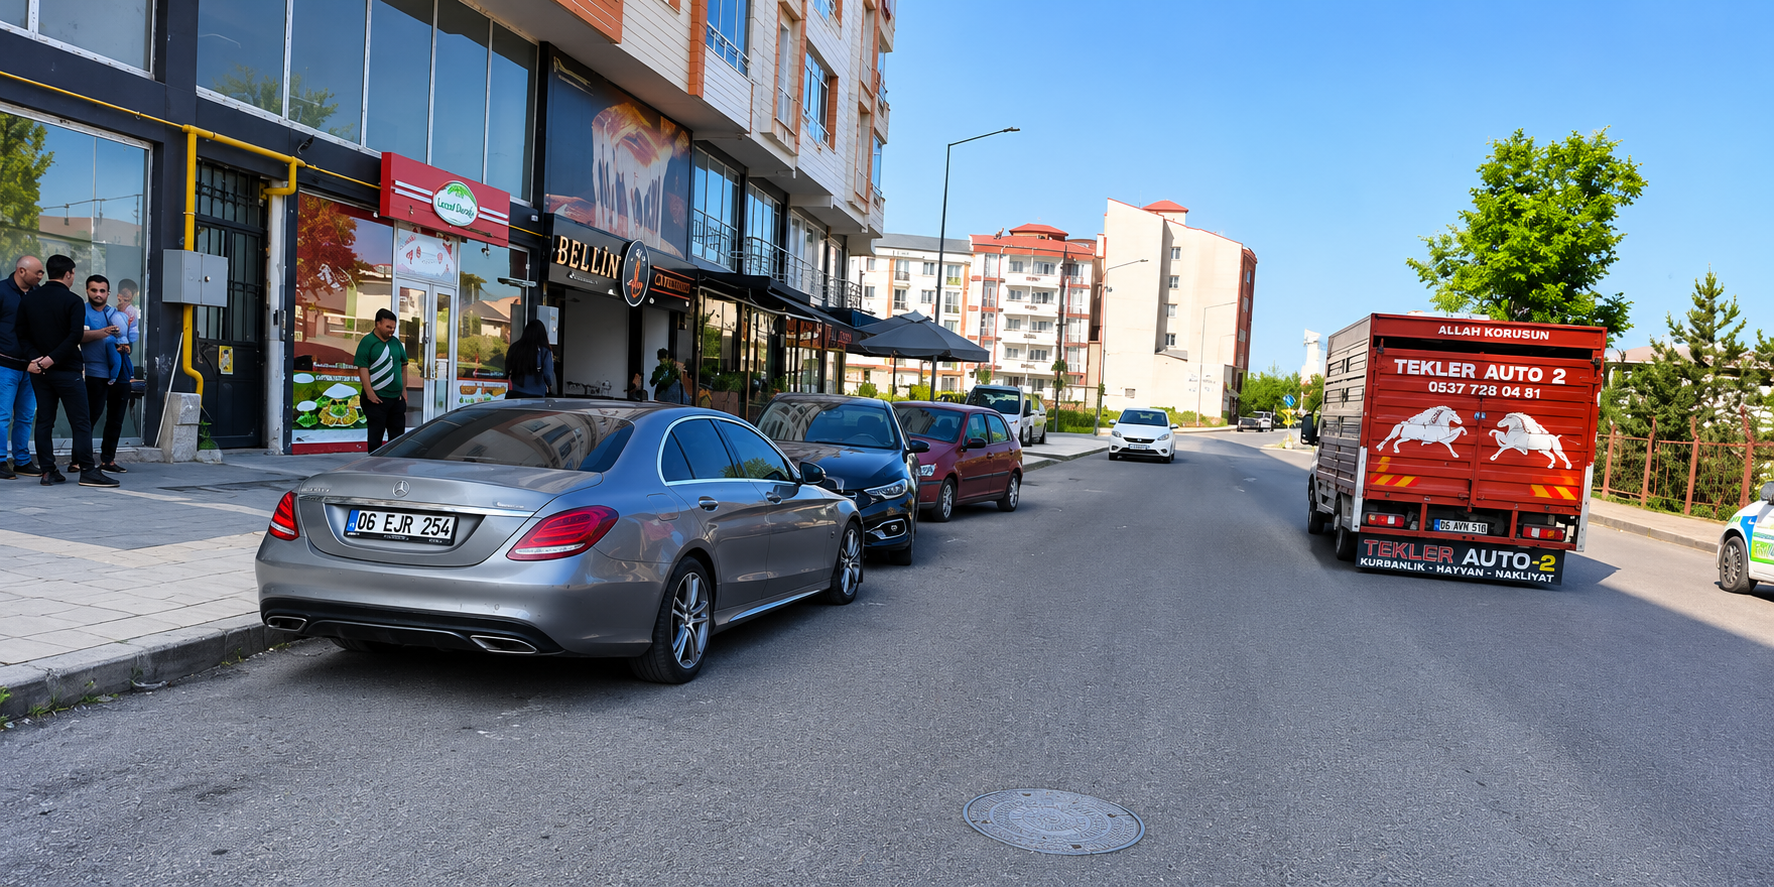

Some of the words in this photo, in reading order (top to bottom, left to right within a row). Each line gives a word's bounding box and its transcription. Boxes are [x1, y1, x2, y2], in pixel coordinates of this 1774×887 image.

[1438, 325, 1481, 336] ALLAH
[1484, 327, 1550, 340] KORUSUN
[1394, 358, 1476, 379] TEKLER
[1484, 364, 1543, 382] AUTO
[1551, 368, 1567, 385] 2
[1428, 381, 1466, 394] 0537
[1470, 384, 1497, 396] 728
[1501, 386, 1520, 398] 04
[1524, 387, 1541, 399] 81
[357, 512, 377, 530] 06
[383, 514, 413, 534] EJR
[420, 517, 450, 536] 254
[1360, 557, 1425, 572] KURBANLIK
[1436, 564, 1484, 577] HAYVAN
[1363, 539, 1454, 564] TEKLER
[1461, 548, 1556, 573] AUTO-2
